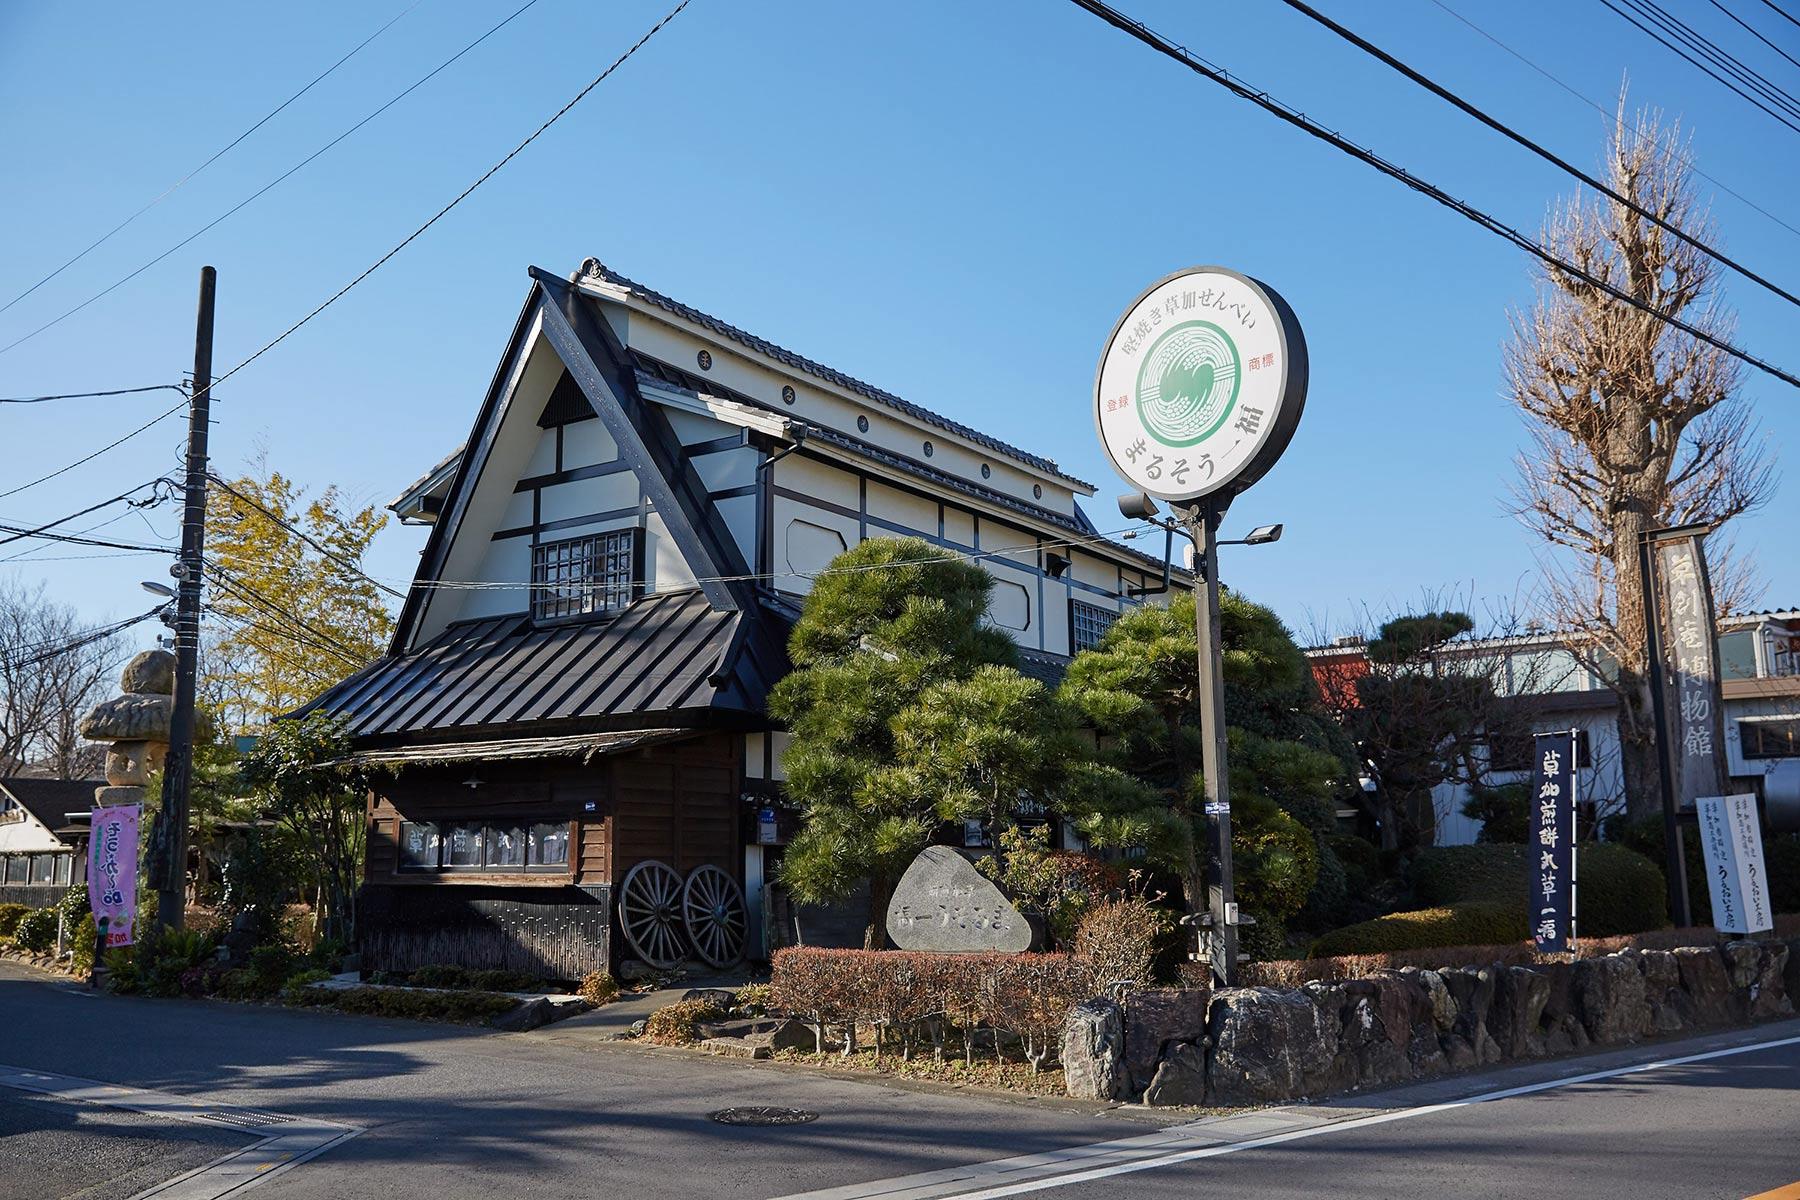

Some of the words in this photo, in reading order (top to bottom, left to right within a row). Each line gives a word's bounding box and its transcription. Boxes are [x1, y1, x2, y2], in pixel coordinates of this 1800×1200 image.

[1121, 288, 1256, 356] 堅焼き草加せんべい
[1248, 352, 1275, 372] 商標
[1106, 395, 1129, 413] 登録
[1125, 404, 1265, 485] まるそう一福
[1536, 750, 1561, 940] 草加煎餅丸草一福
